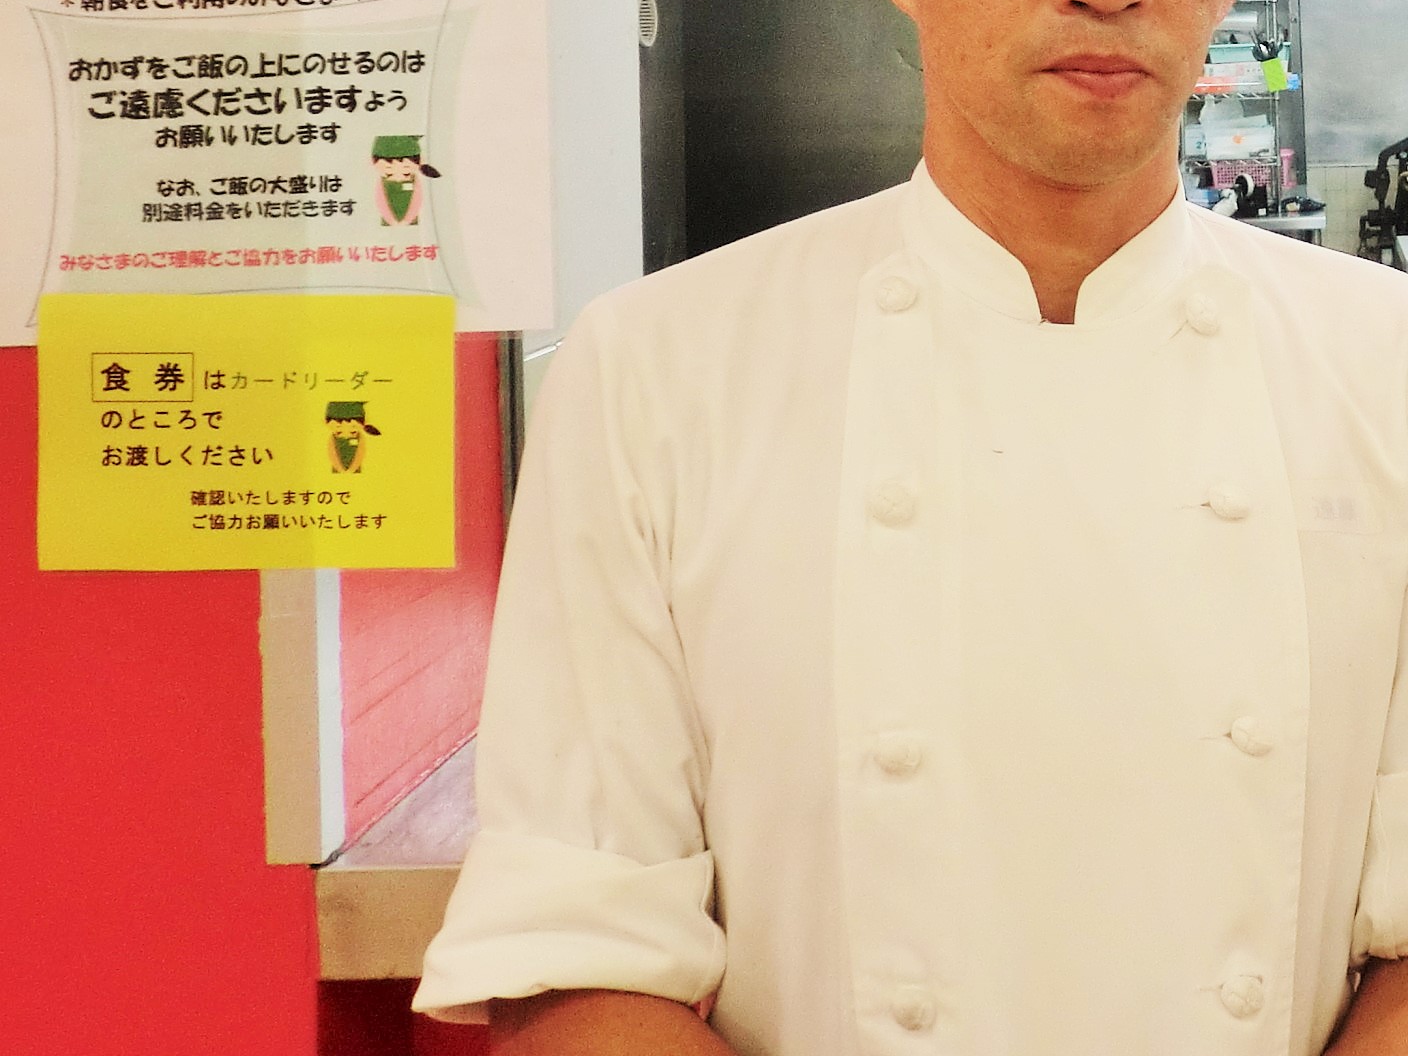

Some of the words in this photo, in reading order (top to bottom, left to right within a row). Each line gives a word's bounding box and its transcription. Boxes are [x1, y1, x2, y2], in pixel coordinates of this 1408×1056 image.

[68, 50, 426, 82] おかずをご飯の上にのせるのは
[88, 86, 408, 120] ご遠慮くださいますよう
[155, 123, 342, 149] お願いいたします
[142, 198, 357, 223] 別途料金をいただきます
[60, 245, 439, 271] みなさまのご理解とご協力をお願いいたします
[101, 409, 223, 430] のところで
[102, 445, 274, 467] お渡しください
[190, 490, 351, 507] 確認いたしますので
[191, 514, 388, 531] ご協力お願いいたします
